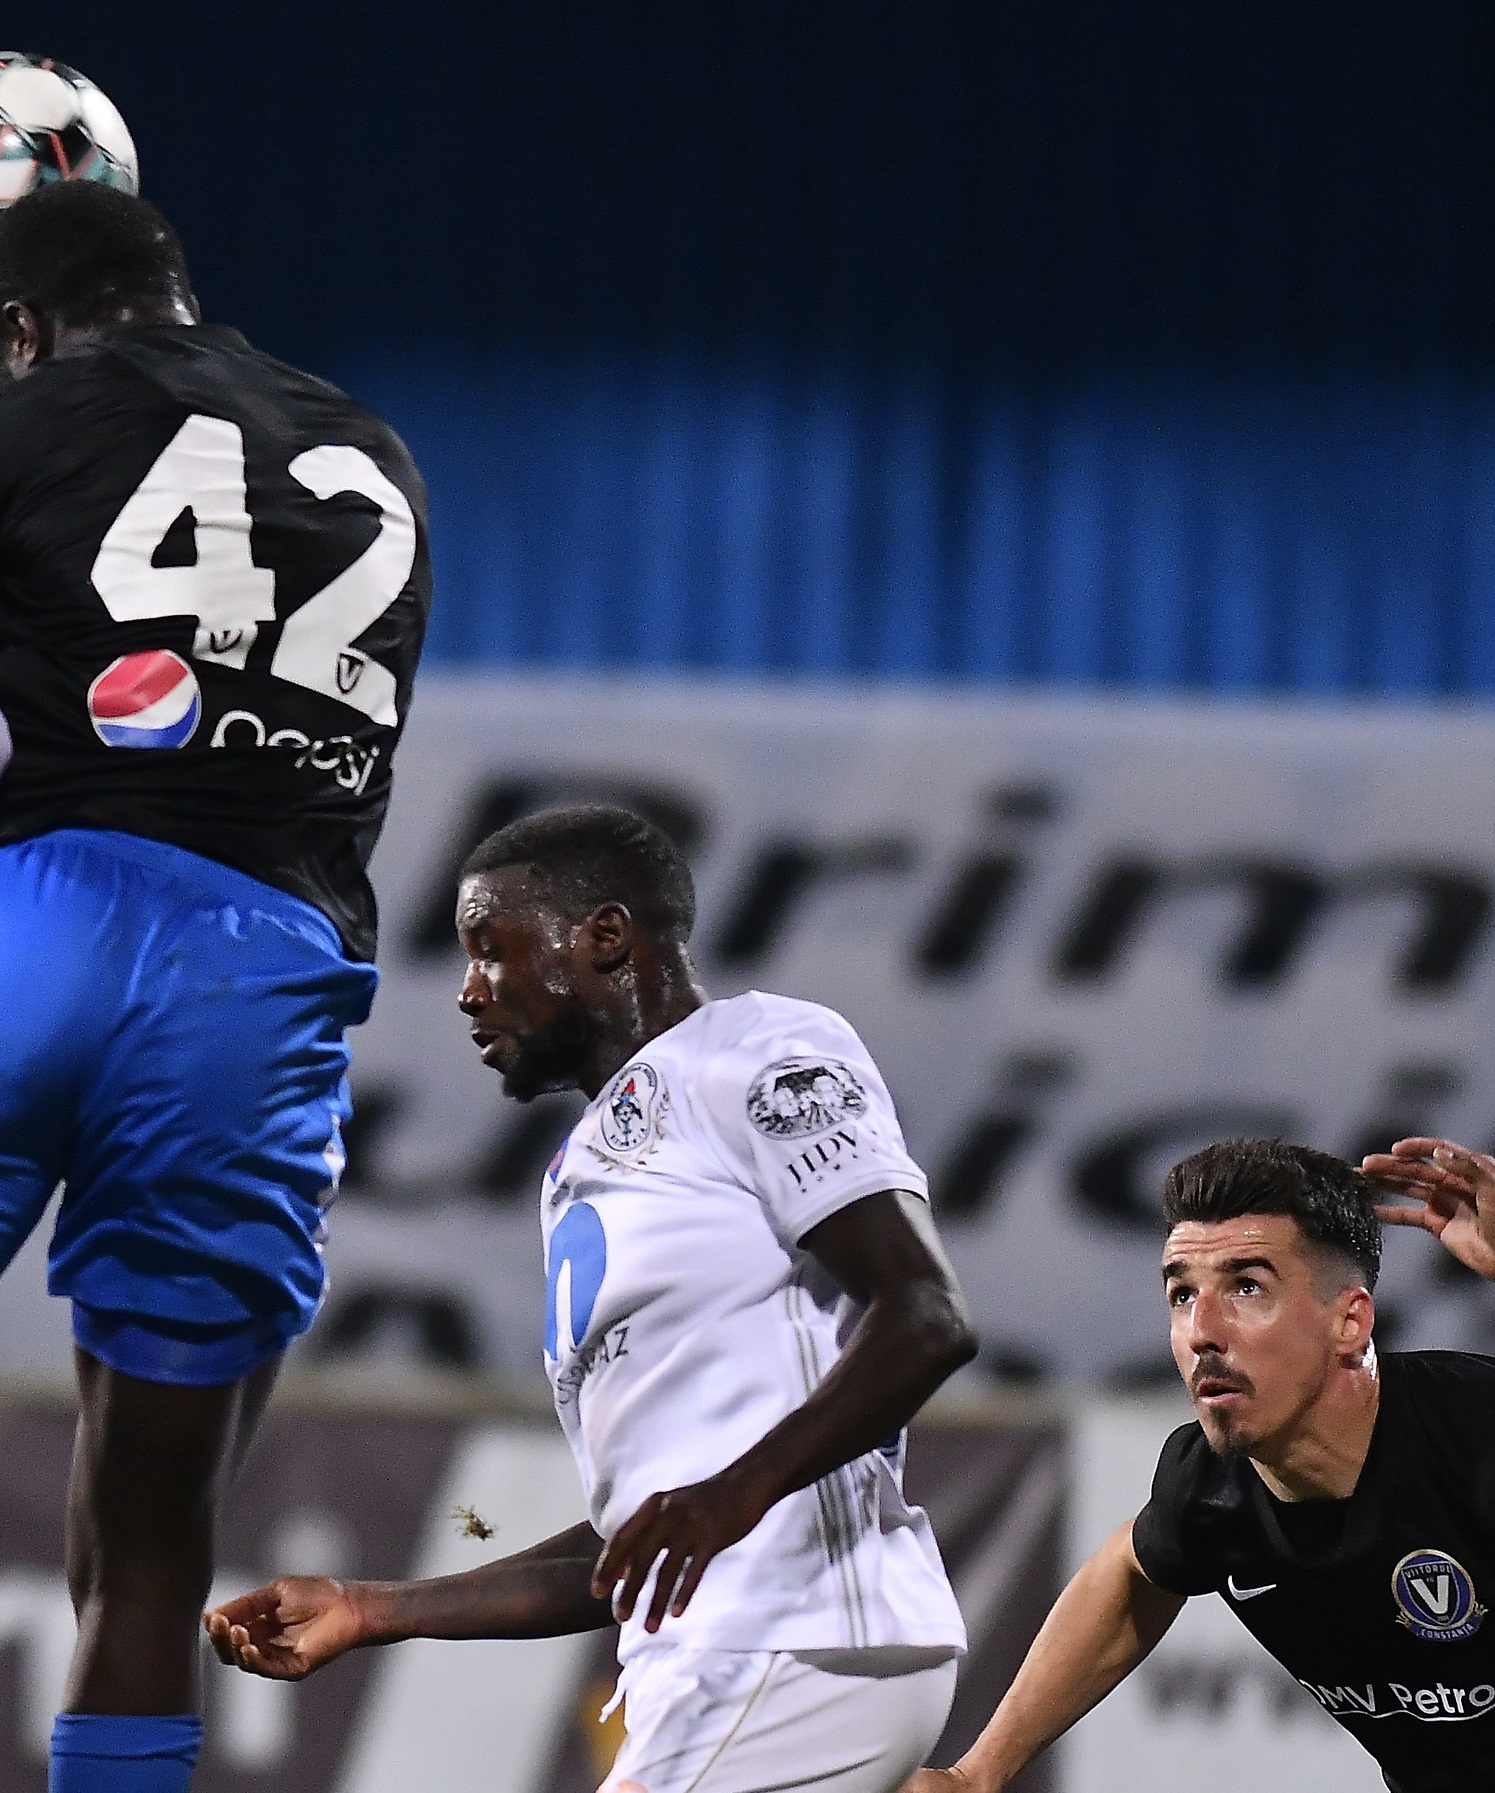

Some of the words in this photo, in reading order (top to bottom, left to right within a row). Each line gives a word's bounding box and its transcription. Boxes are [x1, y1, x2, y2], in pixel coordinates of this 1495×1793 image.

[91, 414, 415, 727] 42
[1405, 1564, 1451, 1578] VIITORUL
[1410, 1574, 1450, 1615] V
